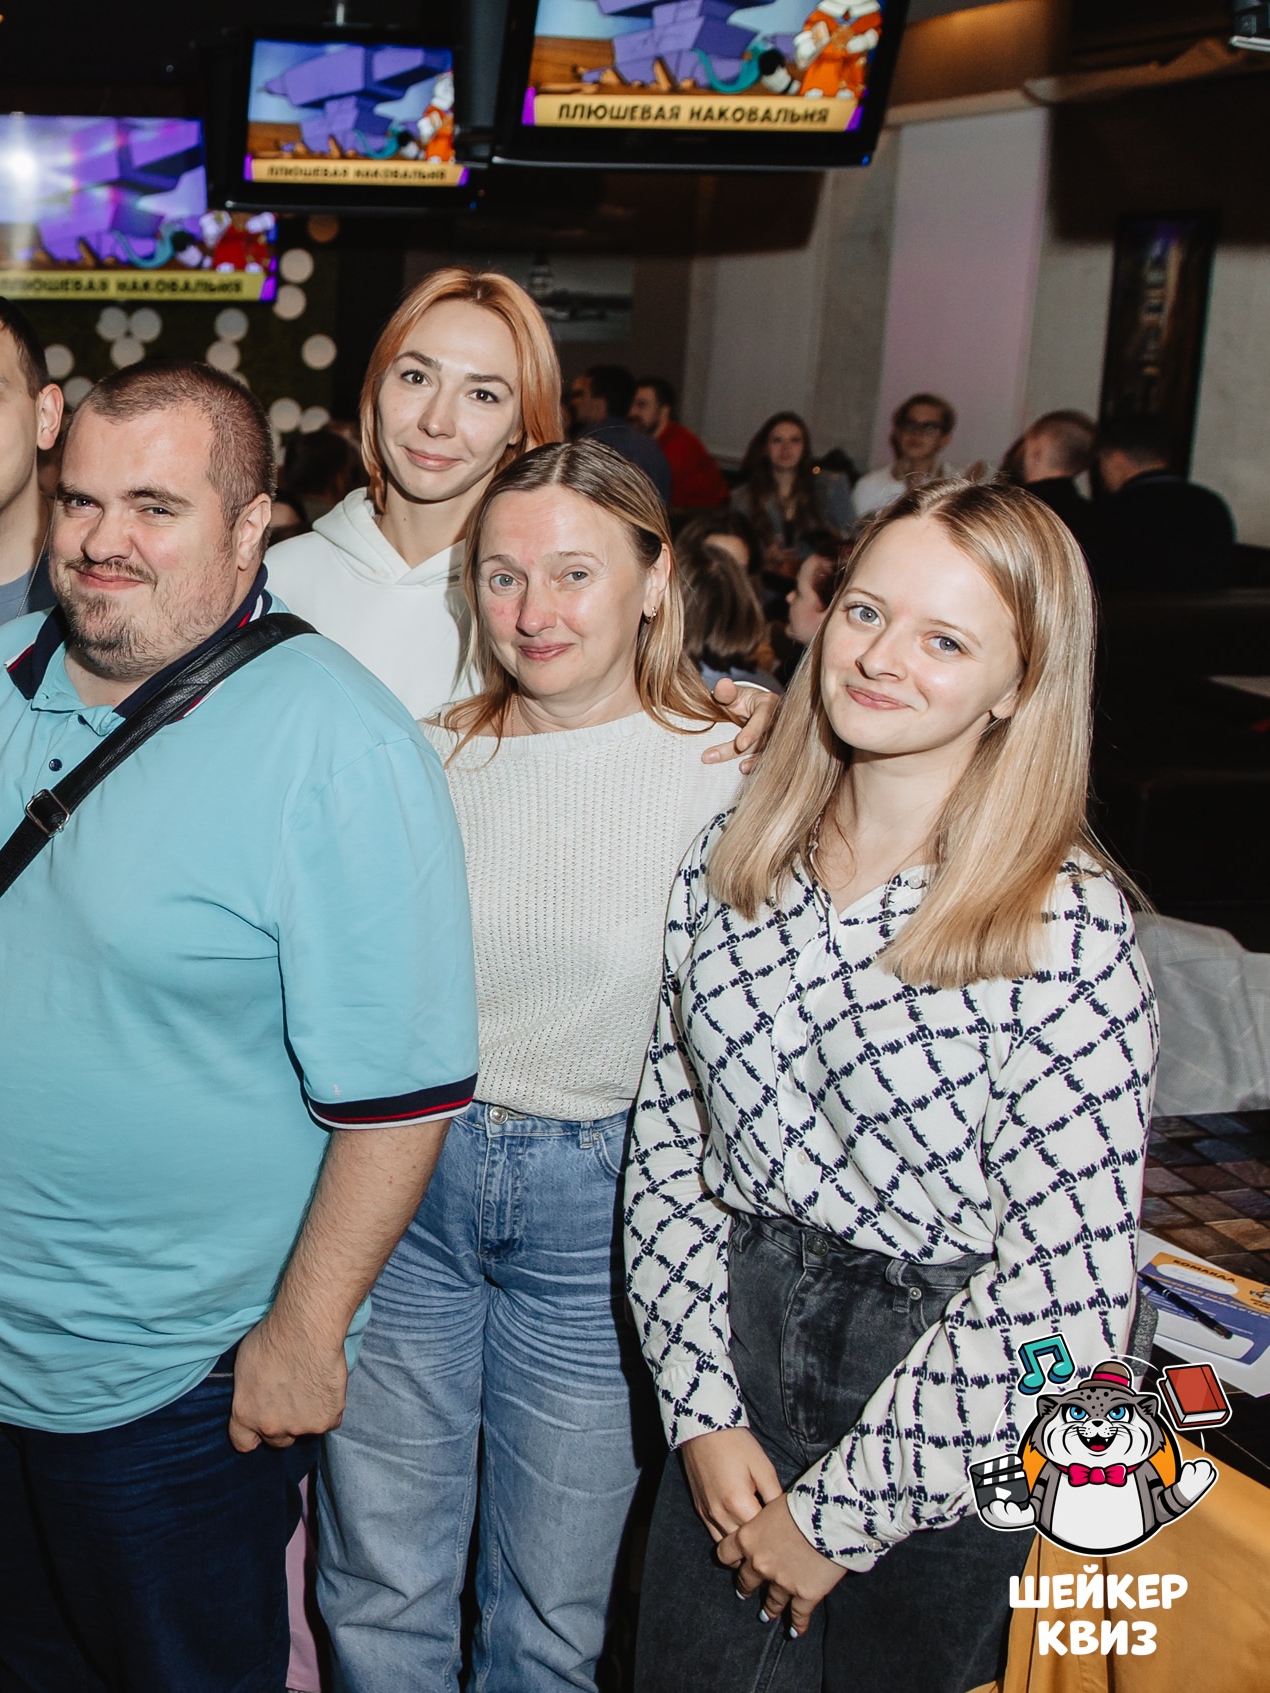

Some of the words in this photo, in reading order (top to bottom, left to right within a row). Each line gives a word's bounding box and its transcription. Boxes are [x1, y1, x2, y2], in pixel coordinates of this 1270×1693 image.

[558, 103, 681, 121] ПЛЮШЕВАЯ
[689, 105, 830, 123] НАКОВАЛЬНЯ
[1173, 1259, 1236, 1283] КОМАНДА
